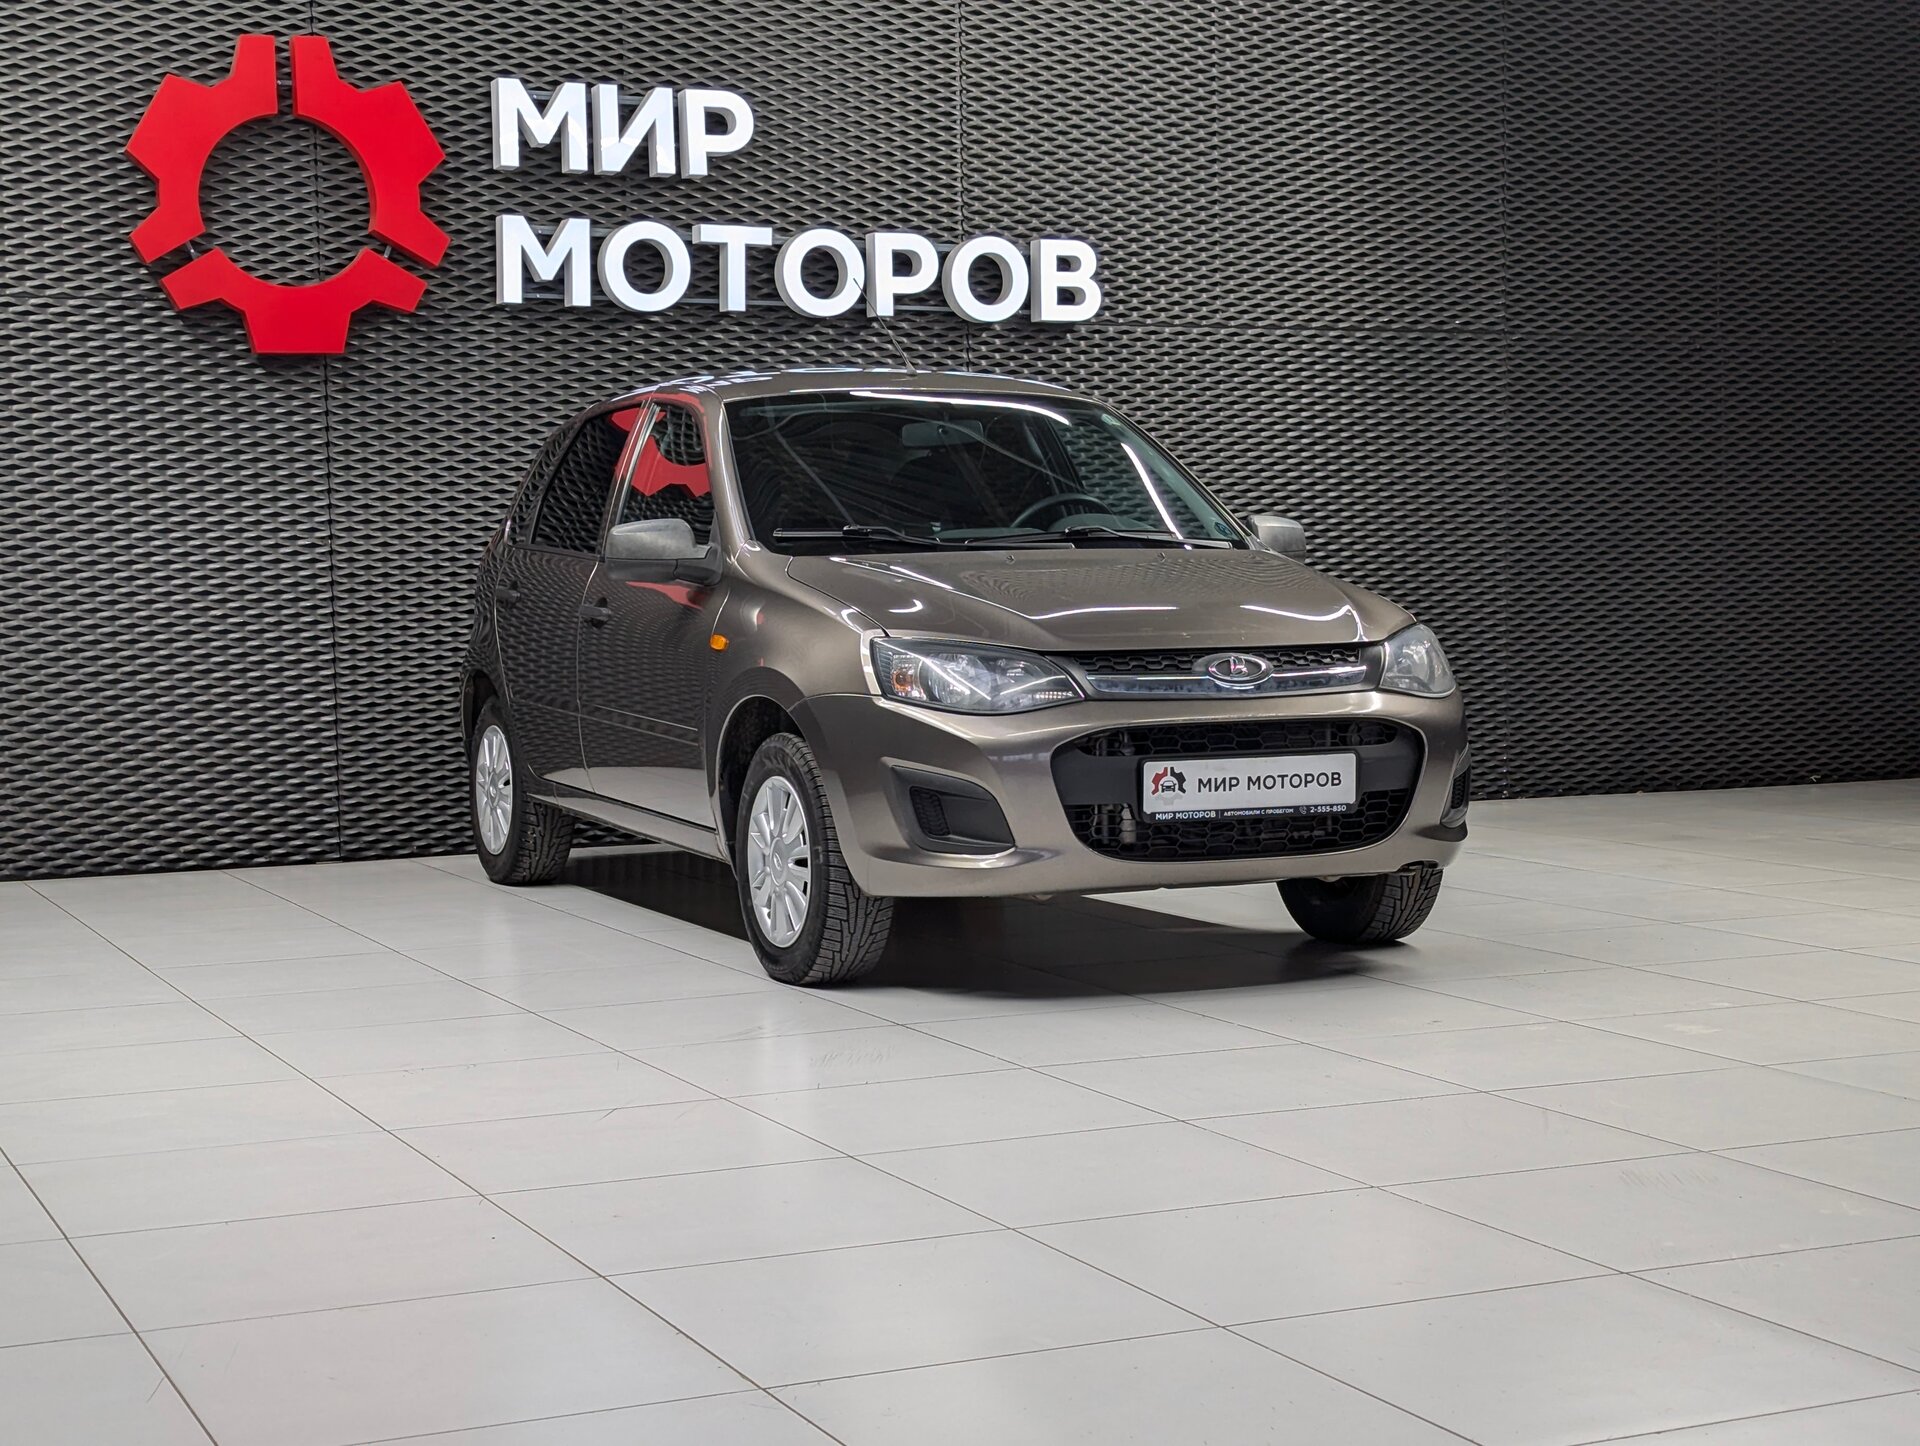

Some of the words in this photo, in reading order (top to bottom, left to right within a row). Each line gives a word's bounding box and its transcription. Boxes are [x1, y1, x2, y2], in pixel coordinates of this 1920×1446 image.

[490, 77, 755, 180] МИР
[495, 214, 1102, 324] МОТОРОВ
[1155, 812, 1174, 820] МИР
[1175, 811, 1216, 819] МОТОРОВ
[1310, 805, 1347, 813] 2-555-850
[1197, 777, 1240, 793] МИР
[1247, 772, 1342, 791] МОТОРОВ
